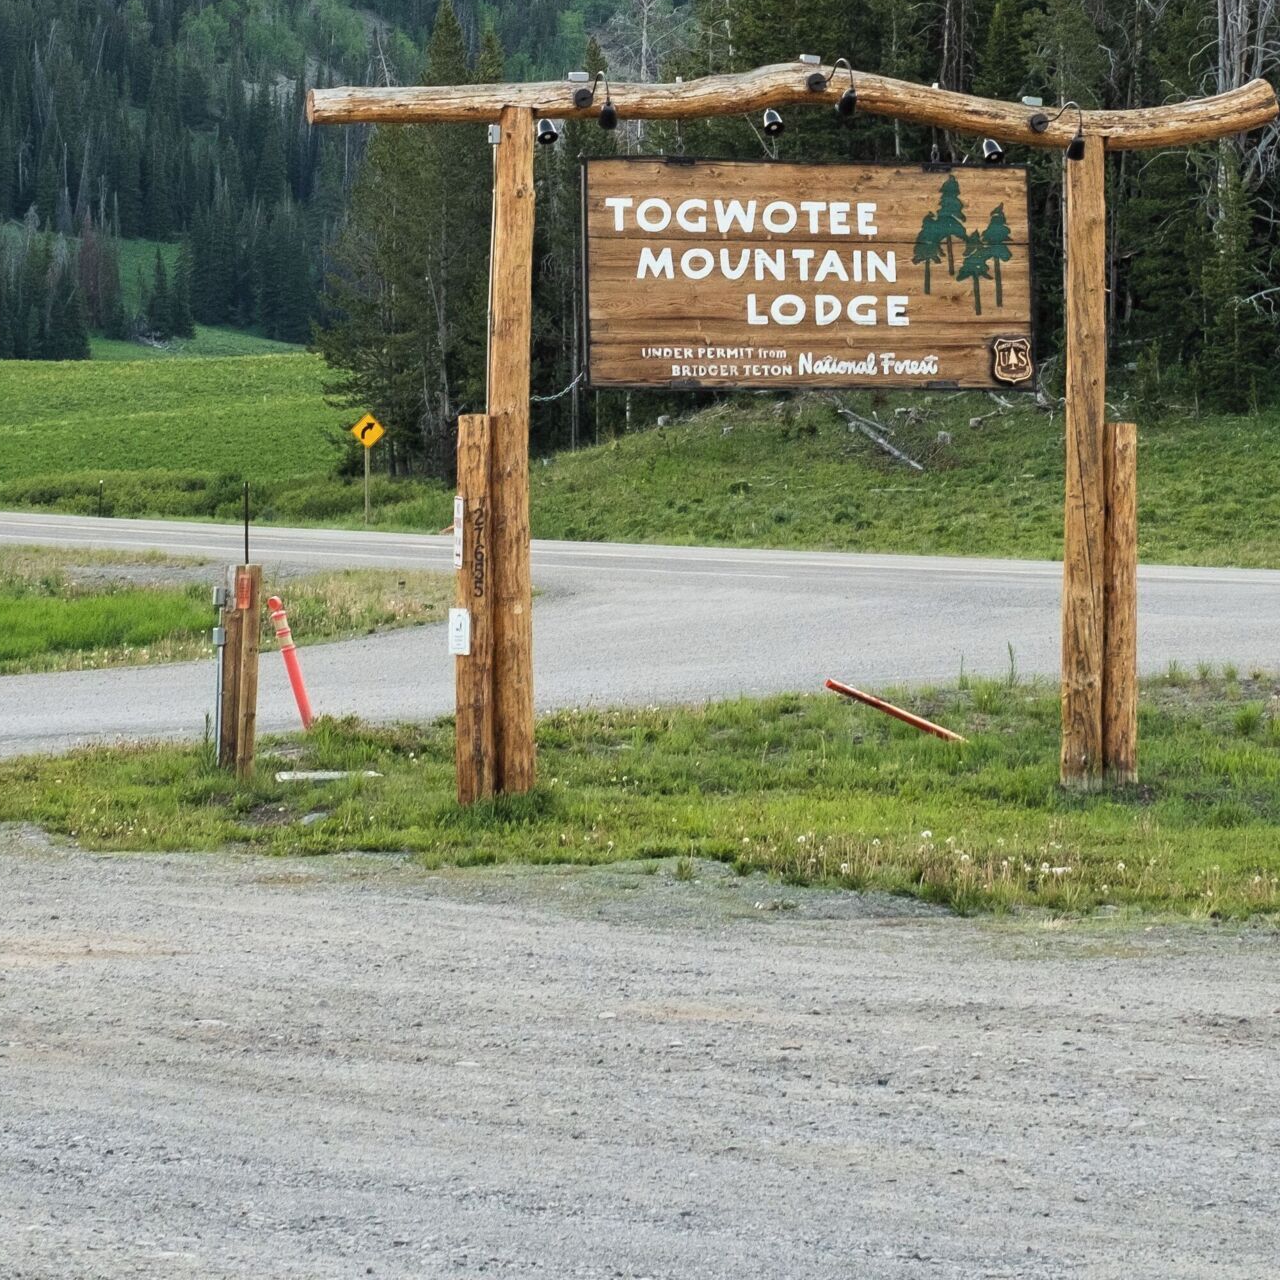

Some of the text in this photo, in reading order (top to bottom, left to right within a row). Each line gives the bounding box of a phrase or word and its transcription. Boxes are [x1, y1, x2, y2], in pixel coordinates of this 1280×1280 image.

[605, 198, 878, 235] TOGWOTEE
[636, 247, 897, 283] MOUNTAIN
[747, 293, 910, 326] LODGE
[641, 347, 787, 359] UNDER PERMIT from
[671, 351, 939, 377] BRIDGER TETON National Forest
[474, 508, 484, 597] 27655
